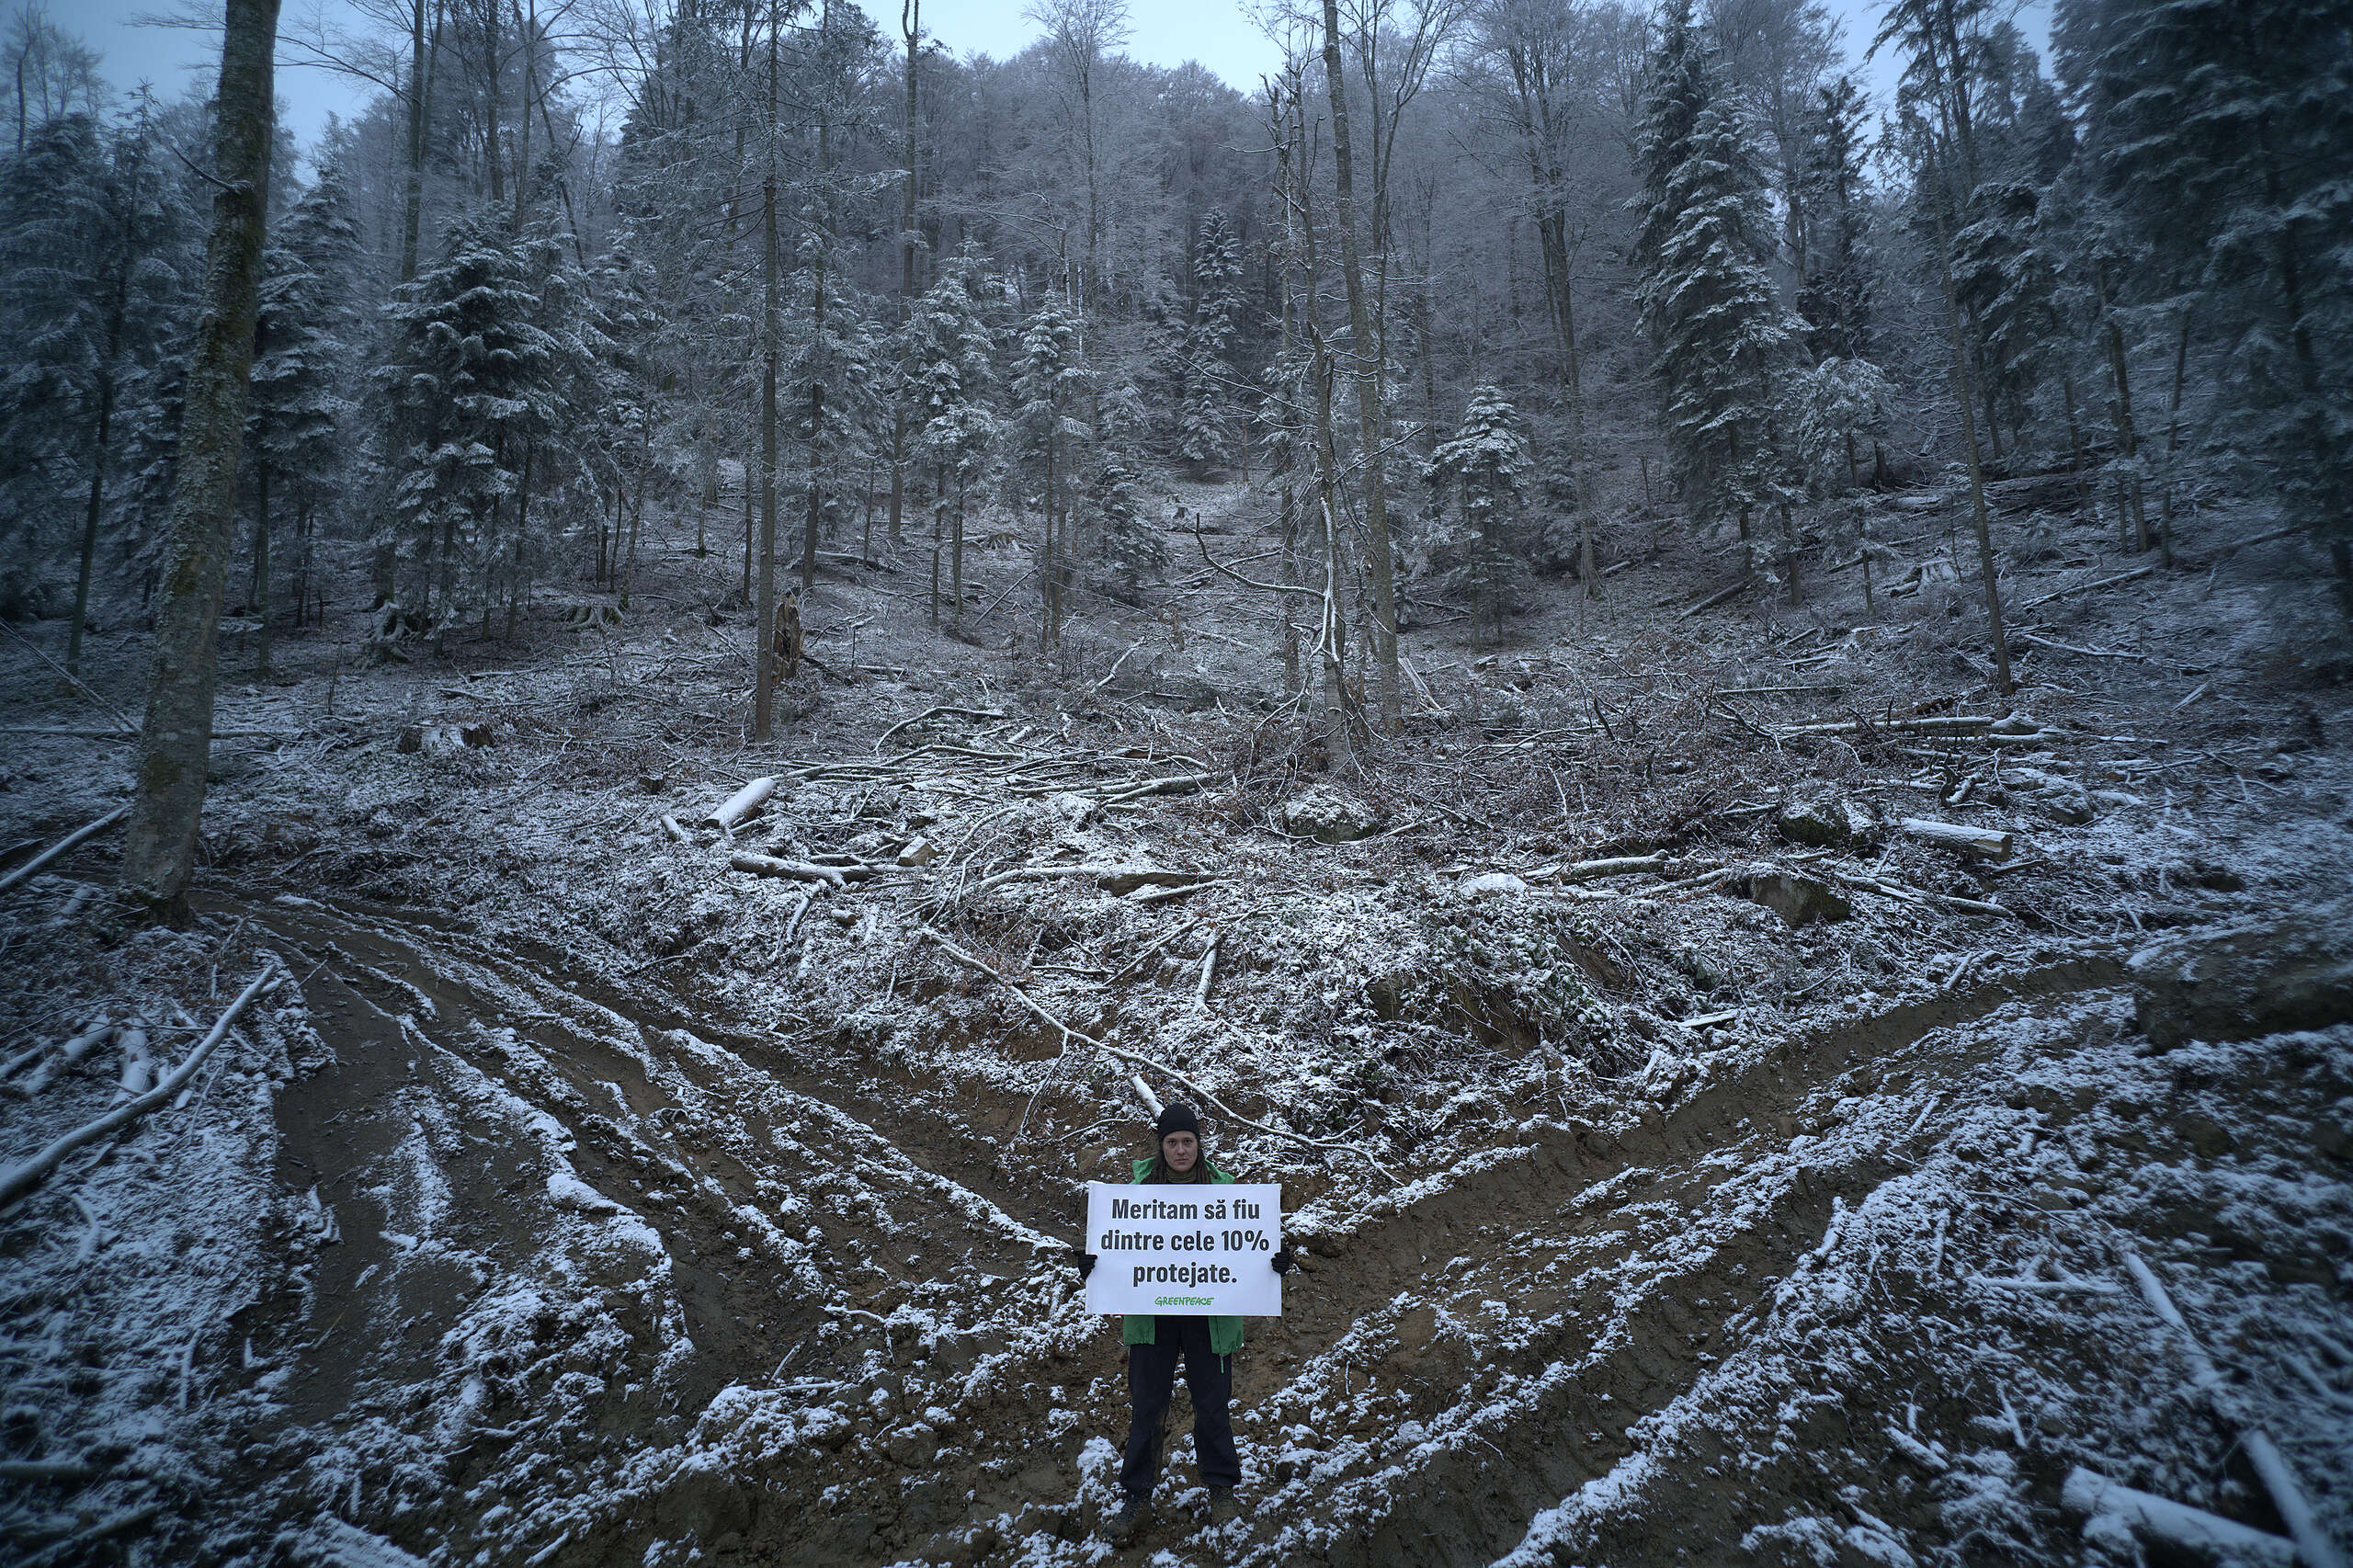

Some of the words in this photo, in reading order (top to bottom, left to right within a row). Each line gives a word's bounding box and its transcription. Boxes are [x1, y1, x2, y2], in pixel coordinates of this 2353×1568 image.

[1111, 1199, 1198, 1220] Meritam
[1204, 1199, 1227, 1220] să
[1232, 1199, 1260, 1220] fiu
[1101, 1229, 1165, 1251] dintre
[1170, 1230, 1215, 1251] cele
[1221, 1230, 1269, 1251] 10%
[1133, 1262, 1237, 1288] protejate.
[1154, 1296, 1214, 1306] GREENPEACE
